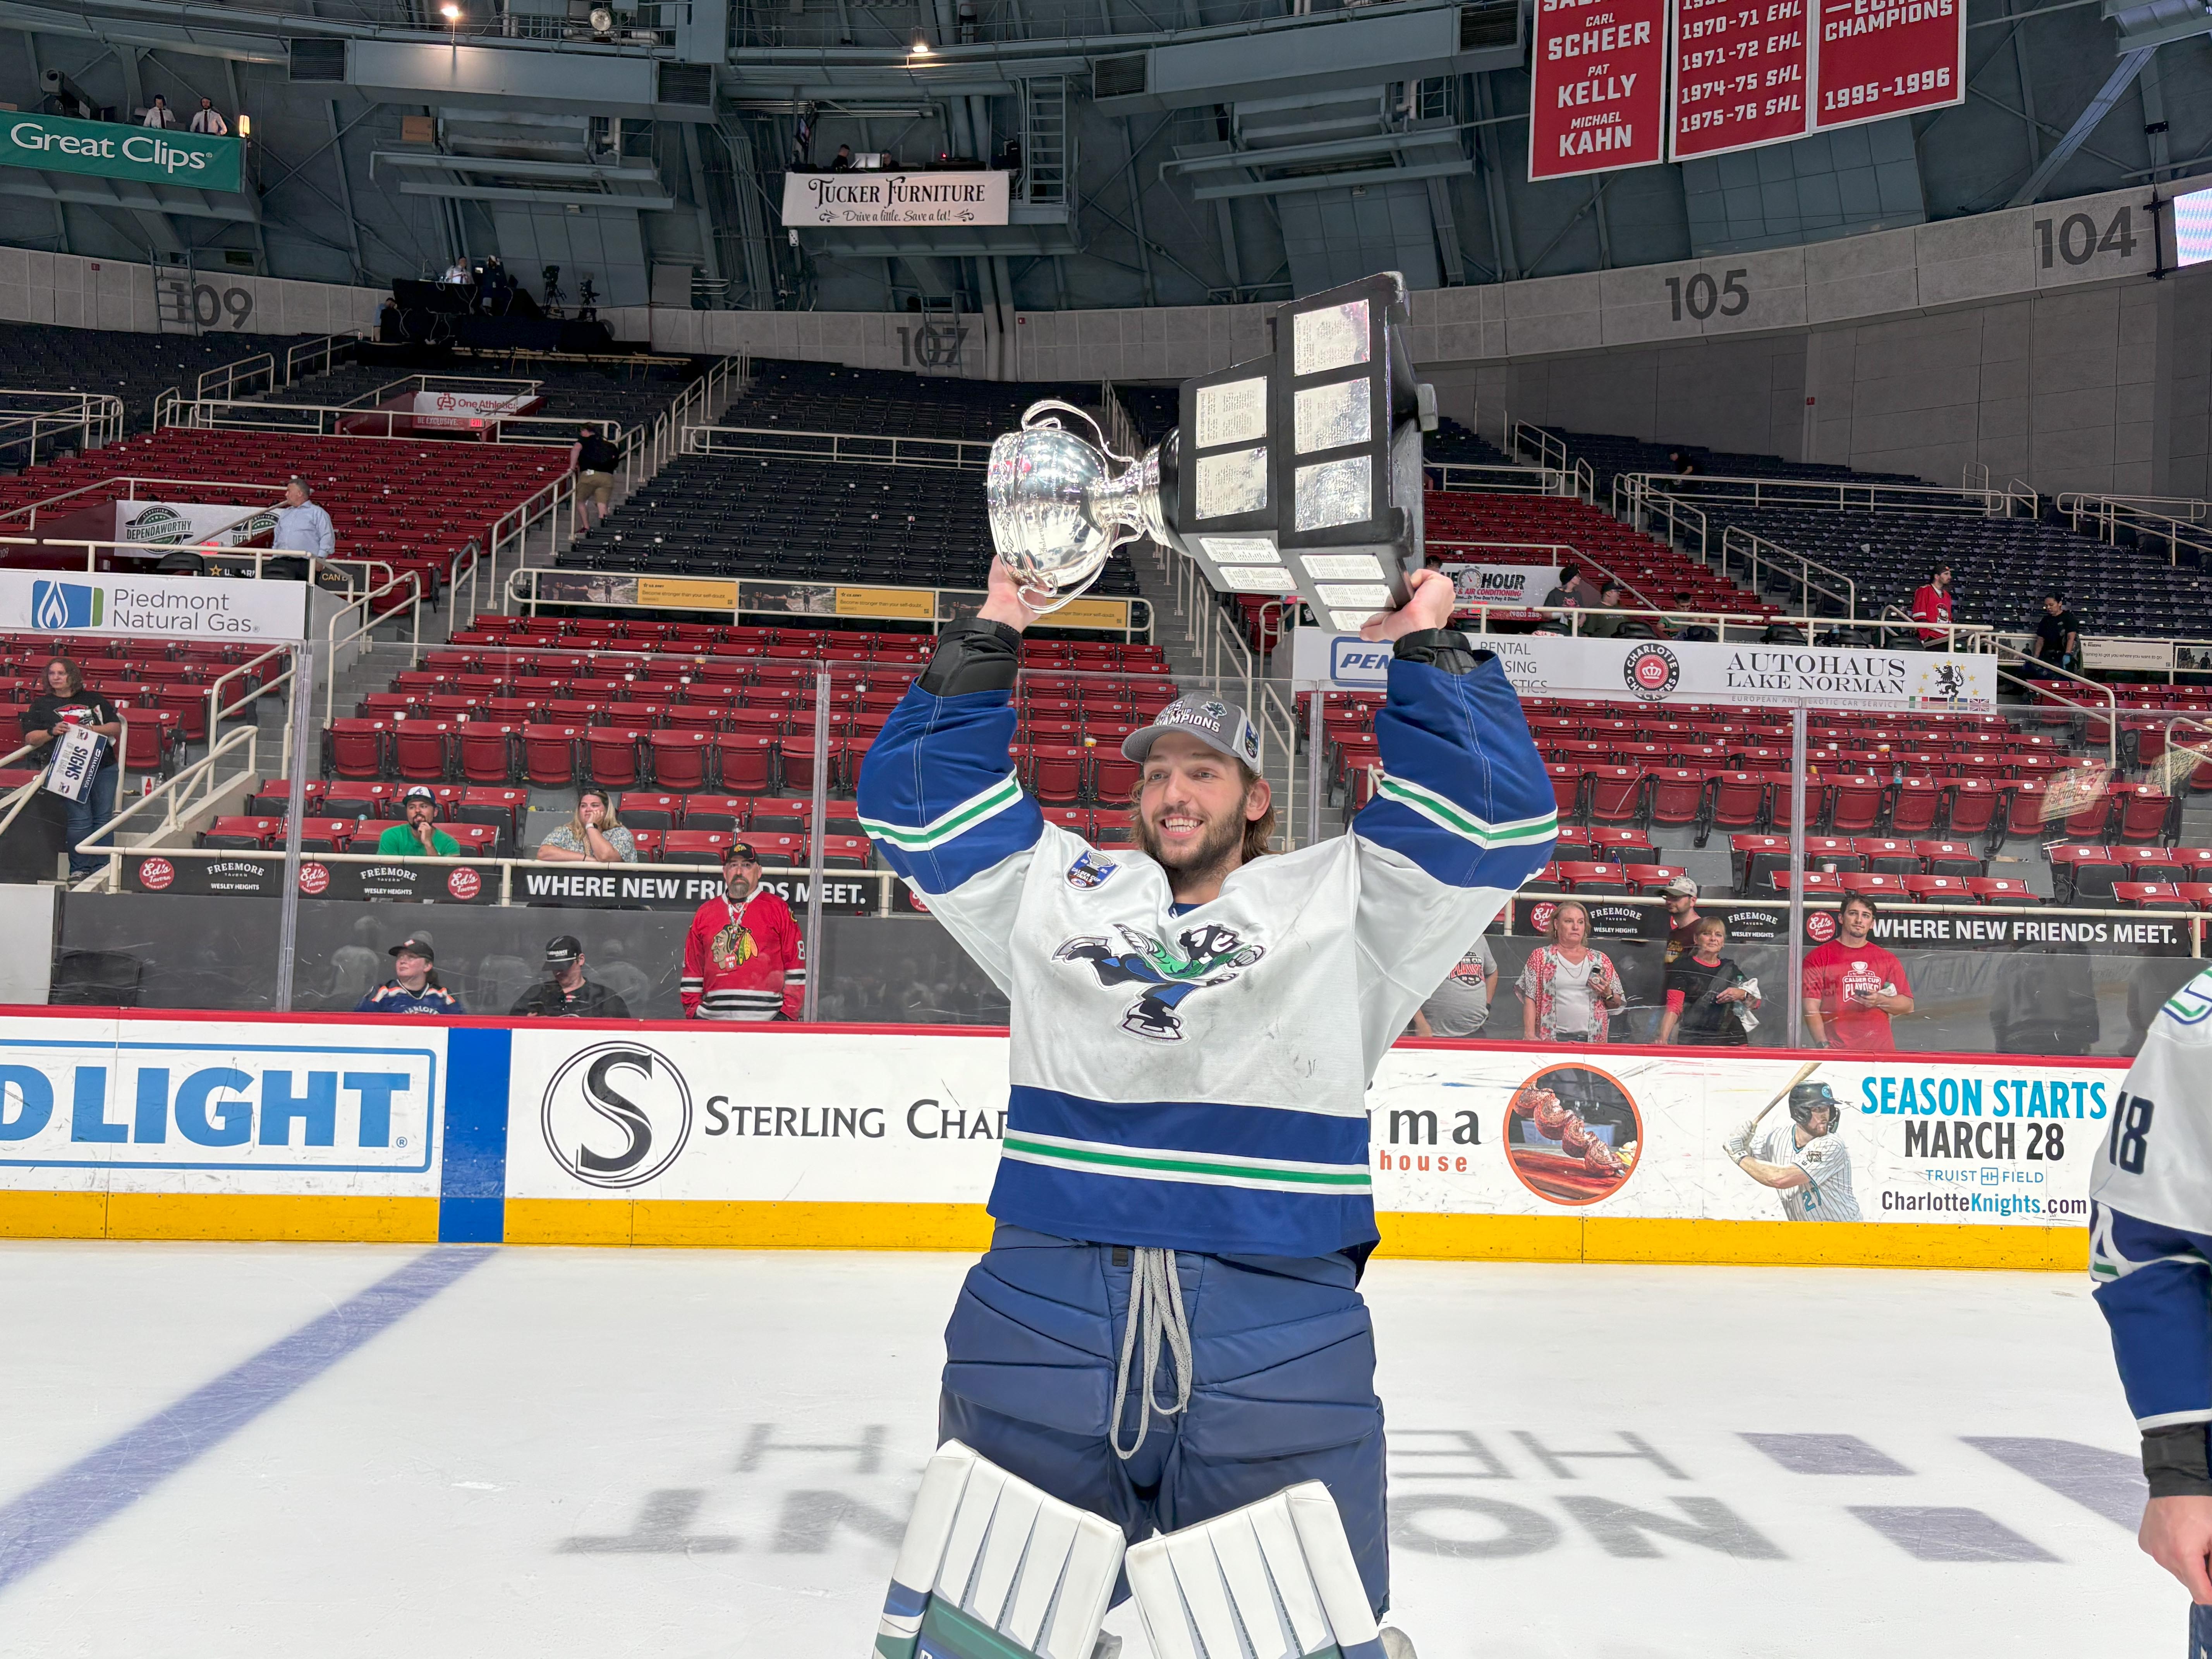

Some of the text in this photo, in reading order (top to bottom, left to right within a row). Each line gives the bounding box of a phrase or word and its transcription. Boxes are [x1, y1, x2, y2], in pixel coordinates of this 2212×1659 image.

[1855, 0, 1920, 14] EC
[1586, 12, 1615, 27] CARL
[1683, 0, 1802, 40] 1970-71 EHL
[1825, 0, 1953, 41] CHAMPIONS
[1548, 21, 1650, 60] SCHEER
[1682, 31, 1802, 71] 1971-72 EHL
[1587, 64, 1610, 77] PAT
[1558, 73, 1637, 108] KELLY
[1681, 64, 1802, 104] 1974-75 SHL
[1824, 67, 1949, 110] 1995-1996
[1571, 111, 1622, 129] MICHAEL
[1681, 94, 1801, 133] 1975-76 SHL
[10, 123, 115, 160] Great
[1559, 124, 1632, 157] KAHN
[808, 176, 985, 210] TUCKER FURNITURE
[843, 210, 871, 222] Drive
[880, 210, 901, 222] little.
[903, 210, 927, 222] Save
[937, 210, 950, 221] lot!
[2035, 206, 2137, 269] 104
[170, 283, 253, 330] 109
[1664, 269, 1749, 322] 105
[897, 326, 970, 368] 107
[458, 399, 477, 408] One
[127, 520, 192, 540] DEPENDAWORTHY
[322, 573, 341, 581] CAN
[1481, 573, 1525, 590] HOUR
[114, 588, 230, 611] Piedmont
[113, 610, 198, 630] Natural
[1480, 641, 1531, 655] RENTAL
[1627, 644, 1678, 669] CHARLOTTE
[1340, 654, 1389, 669] PEN
[1505, 661, 1537, 674] SING
[1726, 652, 1905, 677] AUTOHAUS
[1513, 679, 1547, 693] STICS
[1726, 673, 1906, 694] LAKE NORMAN
[1154, 714, 1221, 733] AMPIONS
[65, 746, 89, 780] SIGNS
[143, 862, 171, 877] Ed's
[207, 862, 264, 876] FREEMORE
[300, 868, 326, 881] Ed's
[359, 867, 417, 881] FREEMORE
[451, 872, 477, 886] Ed's
[1073, 872, 1093, 883] FINALS
[527, 875, 866, 905] WHERE NEW FRIDS MEET.
[1533, 907, 1554, 921] Ed'
[1590, 907, 1642, 921] FREEMORE
[1728, 912, 1778, 925] FREEMORE
[1809, 916, 1833, 930] Ed's
[1872, 919, 2178, 945] WHERE NEW FRIENDS MEET.
[0, 1064, 54, 1141] D
[1861, 1076, 2107, 1119] SEASON STARTS
[705, 1095, 886, 1139] STERLING
[1905, 1120, 2064, 1161] MARCH 28
[2109, 1091, 2155, 1176] 18
[1380, 1150, 1467, 1172] house
[1925, 1169, 2044, 1183] TRUIST FIELD
[1881, 1190, 2087, 1217] CharlotteKnights.com
